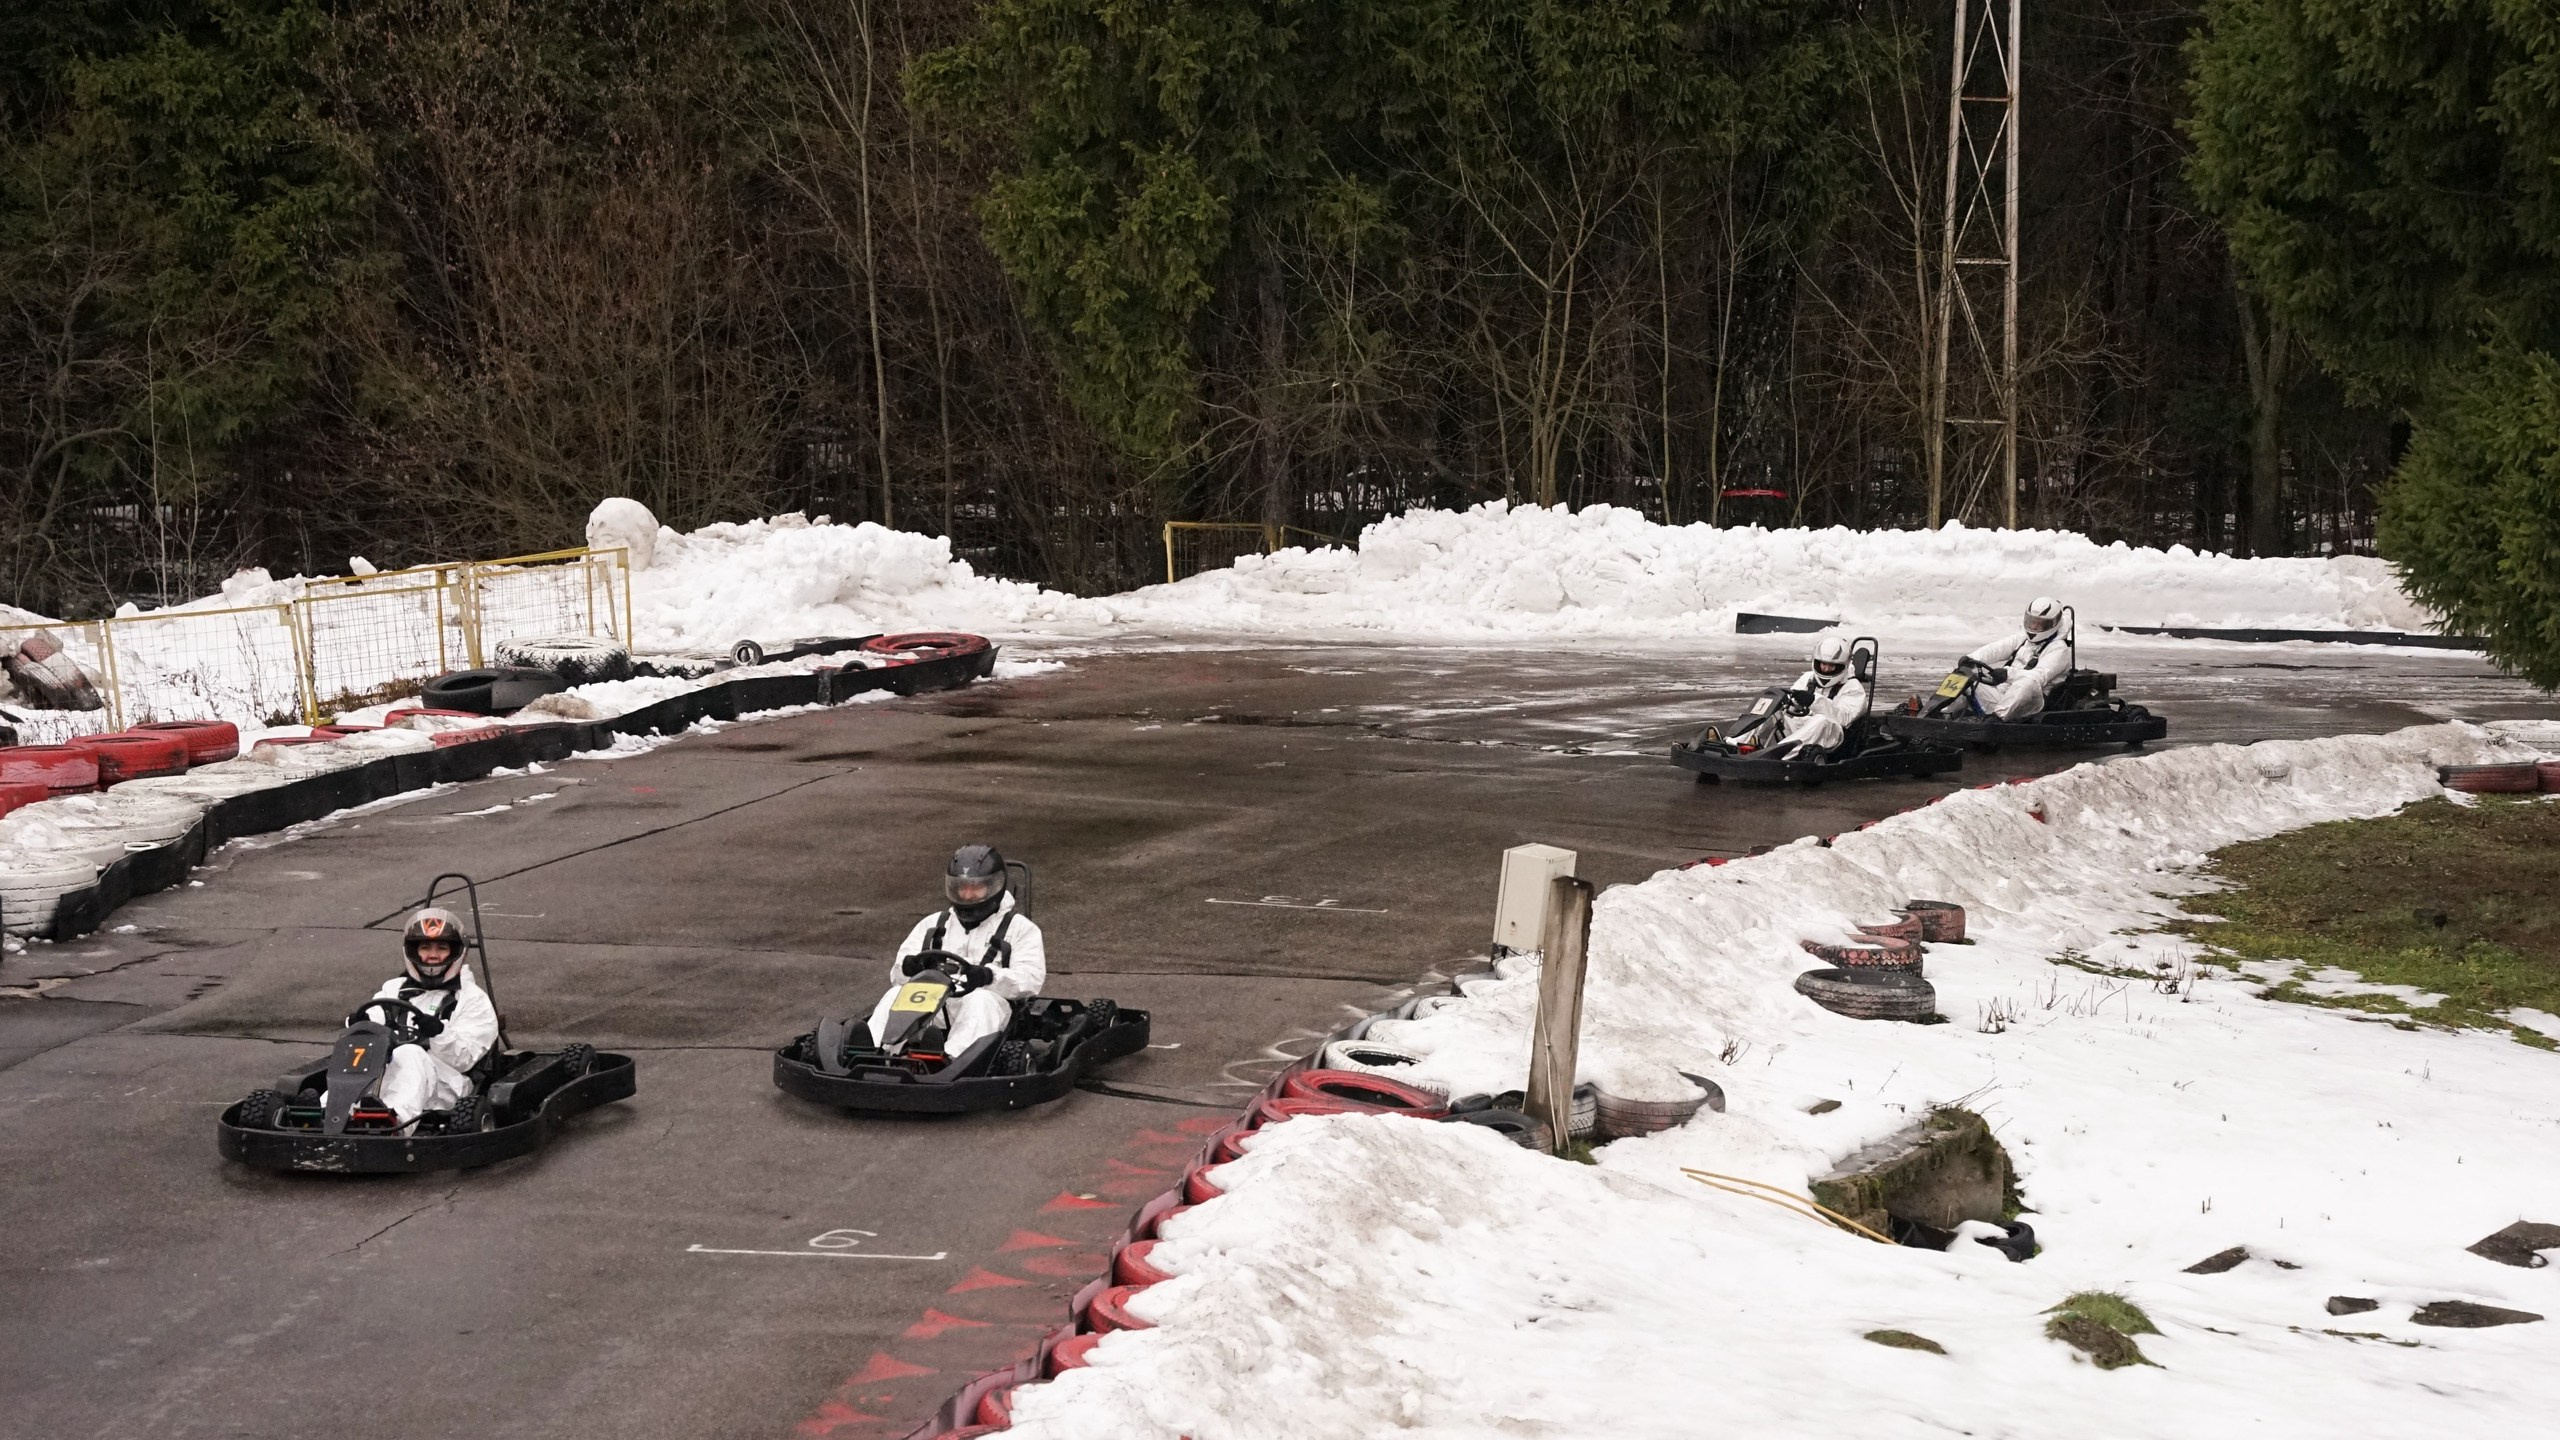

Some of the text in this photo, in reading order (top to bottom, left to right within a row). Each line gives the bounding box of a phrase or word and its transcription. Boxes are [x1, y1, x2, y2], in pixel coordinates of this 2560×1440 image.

[1943, 679, 1960, 692] 14
[909, 990, 928, 1004] 6
[352, 1047, 366, 1067] 7
